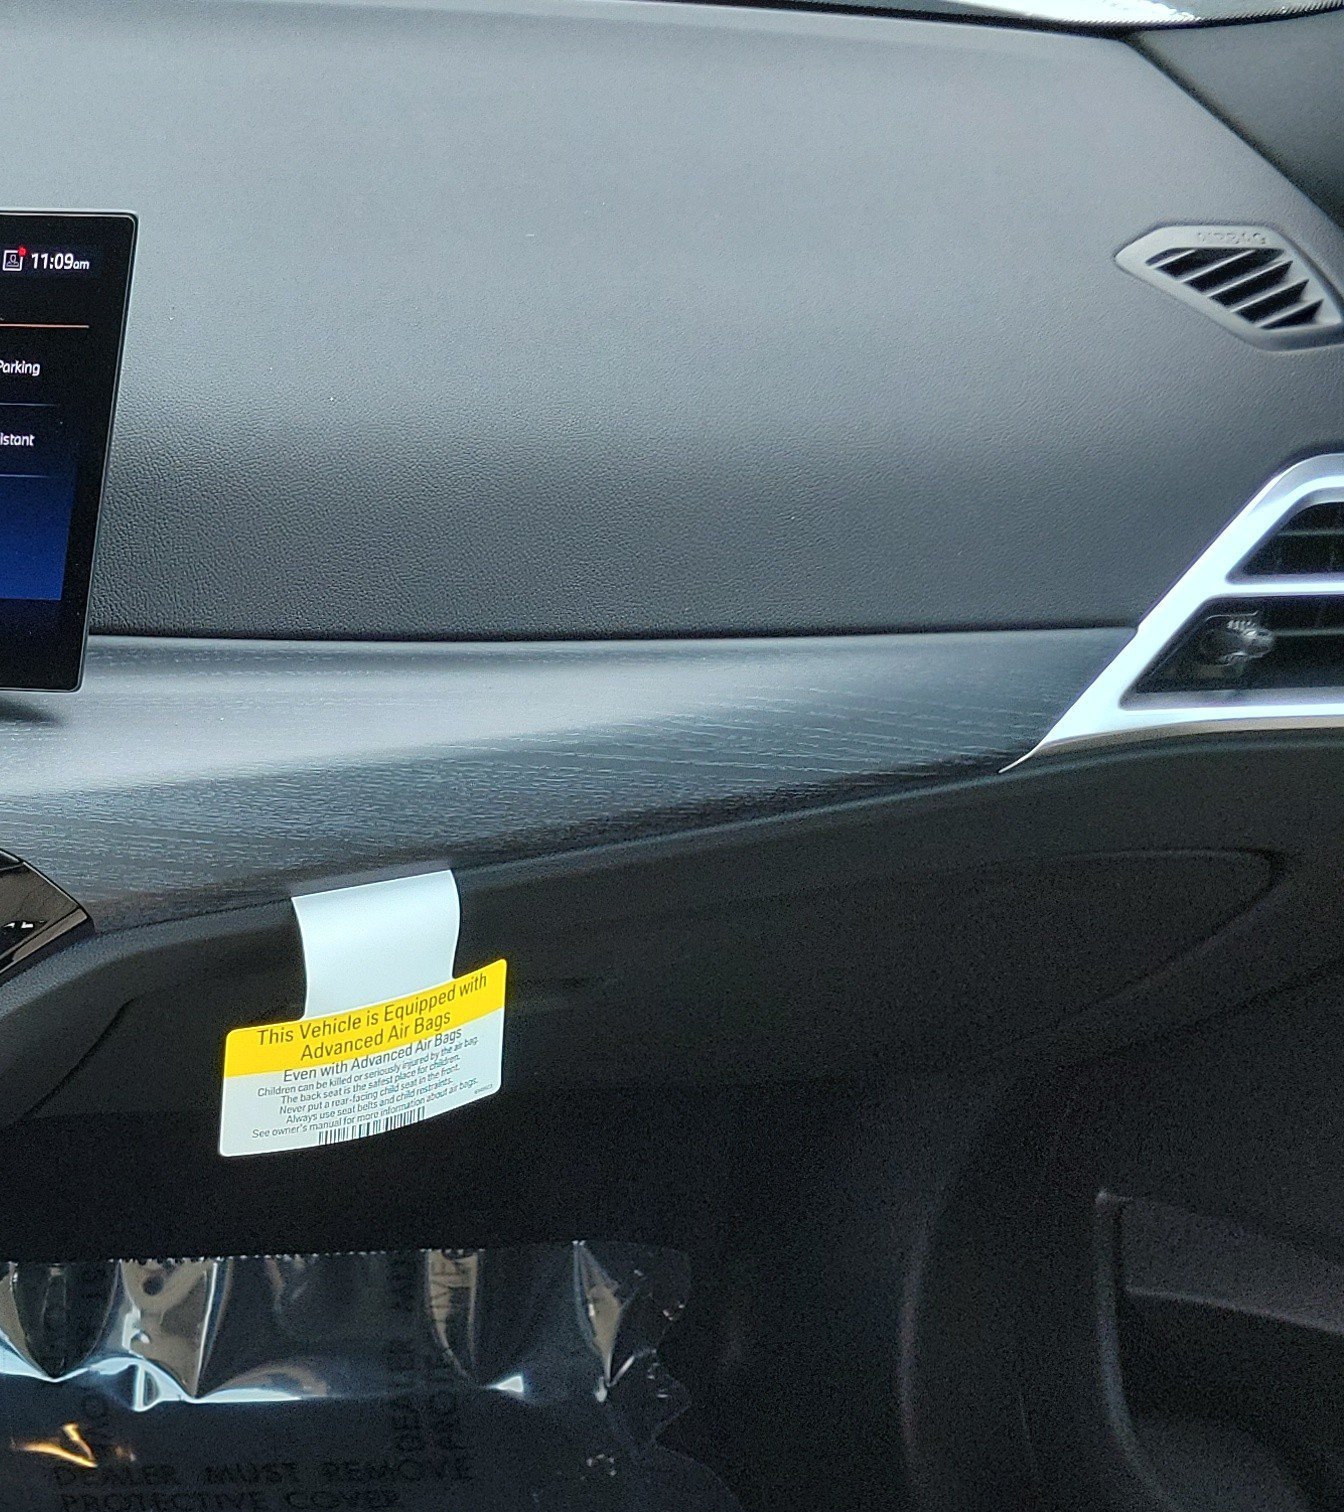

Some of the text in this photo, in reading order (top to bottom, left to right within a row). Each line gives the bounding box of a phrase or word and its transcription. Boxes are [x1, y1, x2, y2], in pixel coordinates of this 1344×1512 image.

[31, 252, 90, 270] 11:09am
[257, 972, 487, 1046] This Vehicle is Equipped with
[284, 1028, 462, 1082] Even with Advanced Air Bags
[300, 1012, 450, 1061] Advanced Air Bags
[258, 1086, 296, 1097] Children
[298, 1082, 314, 1093] can
[316, 1080, 328, 1090] be
[330, 1075, 352, 1087] killed
[354, 1074, 362, 1082] or
[364, 1064, 400, 1080] seriously
[430, 1051, 440, 1061] by
[280, 1066, 428, 1104] The back seat is the safest place for
[280, 1104, 306, 1115] Never
[308, 1102, 323, 1113] put
[332, 1090, 378, 1108] rear-facing
[380, 1084, 399, 1096] child
[400, 1079, 418, 1090] seat
[286, 1112, 318, 1124] Always
[320, 1110, 336, 1120] use
[337, 1106, 356, 1117] seat
[358, 1100, 378, 1112] belts
[379, 1095, 396, 1106] and
[396, 1090, 416, 1102] child
[252, 1128, 270, 1138] See
[272, 1124, 308, 1136] owner's
[310, 1118, 342, 1132] manual
[344, 1116, 356, 1125] for
[357, 1112, 378, 1122] more
[380, 1096, 425, 1117] information
[54, 1458, 473, 1486] DEALER MUST REMOVE
[62, 1490, 400, 1512] PROTECTIVE COVER
